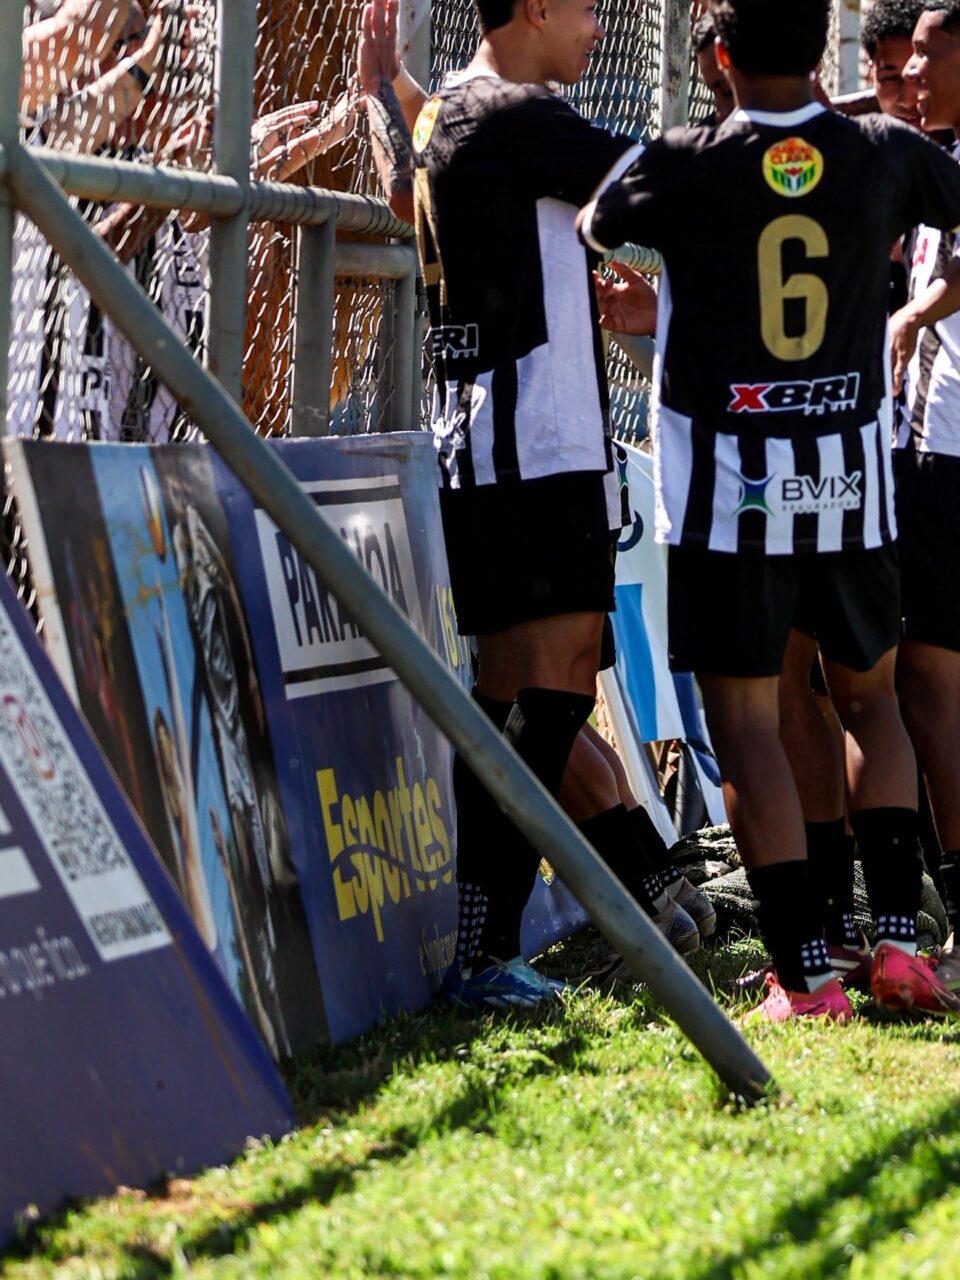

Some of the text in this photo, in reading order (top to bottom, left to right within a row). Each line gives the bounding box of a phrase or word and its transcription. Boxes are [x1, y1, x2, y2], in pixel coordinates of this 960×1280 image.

[756, 213, 830, 362] 6
[430, 323, 480, 359] BRI
[727, 371, 861, 414] XBRI
[781, 472, 861, 502] BVIX
[316, 756, 452, 943] Esportes
